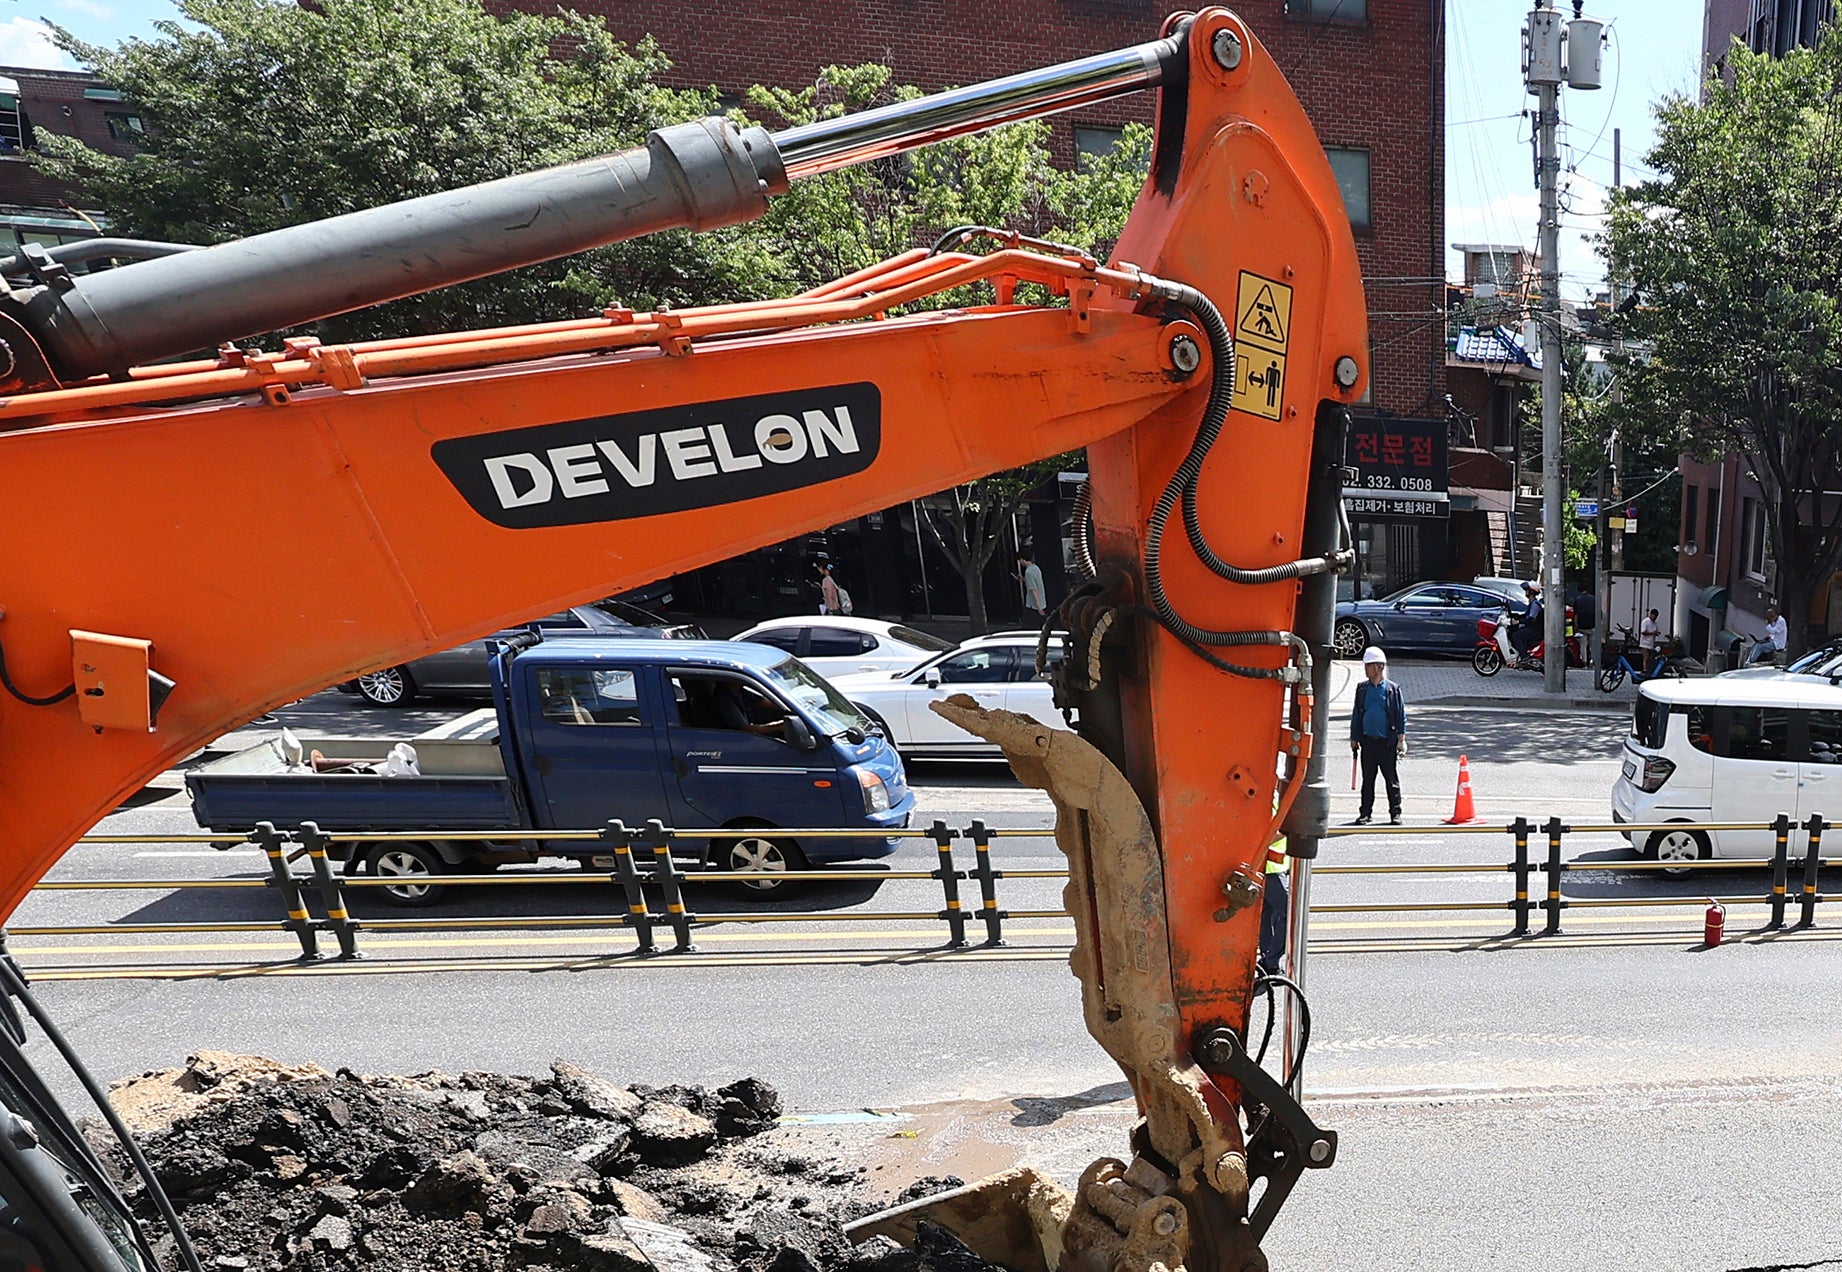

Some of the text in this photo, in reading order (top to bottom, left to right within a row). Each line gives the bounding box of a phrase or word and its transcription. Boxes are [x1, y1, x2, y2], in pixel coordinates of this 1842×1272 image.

[483, 405, 861, 510] DEVELON
[1354, 433, 1433, 467] 전문점
[1367, 475, 1395, 489] 332.
[1400, 477, 1433, 491] 0508
[1393, 500, 1436, 515] 보험처리
